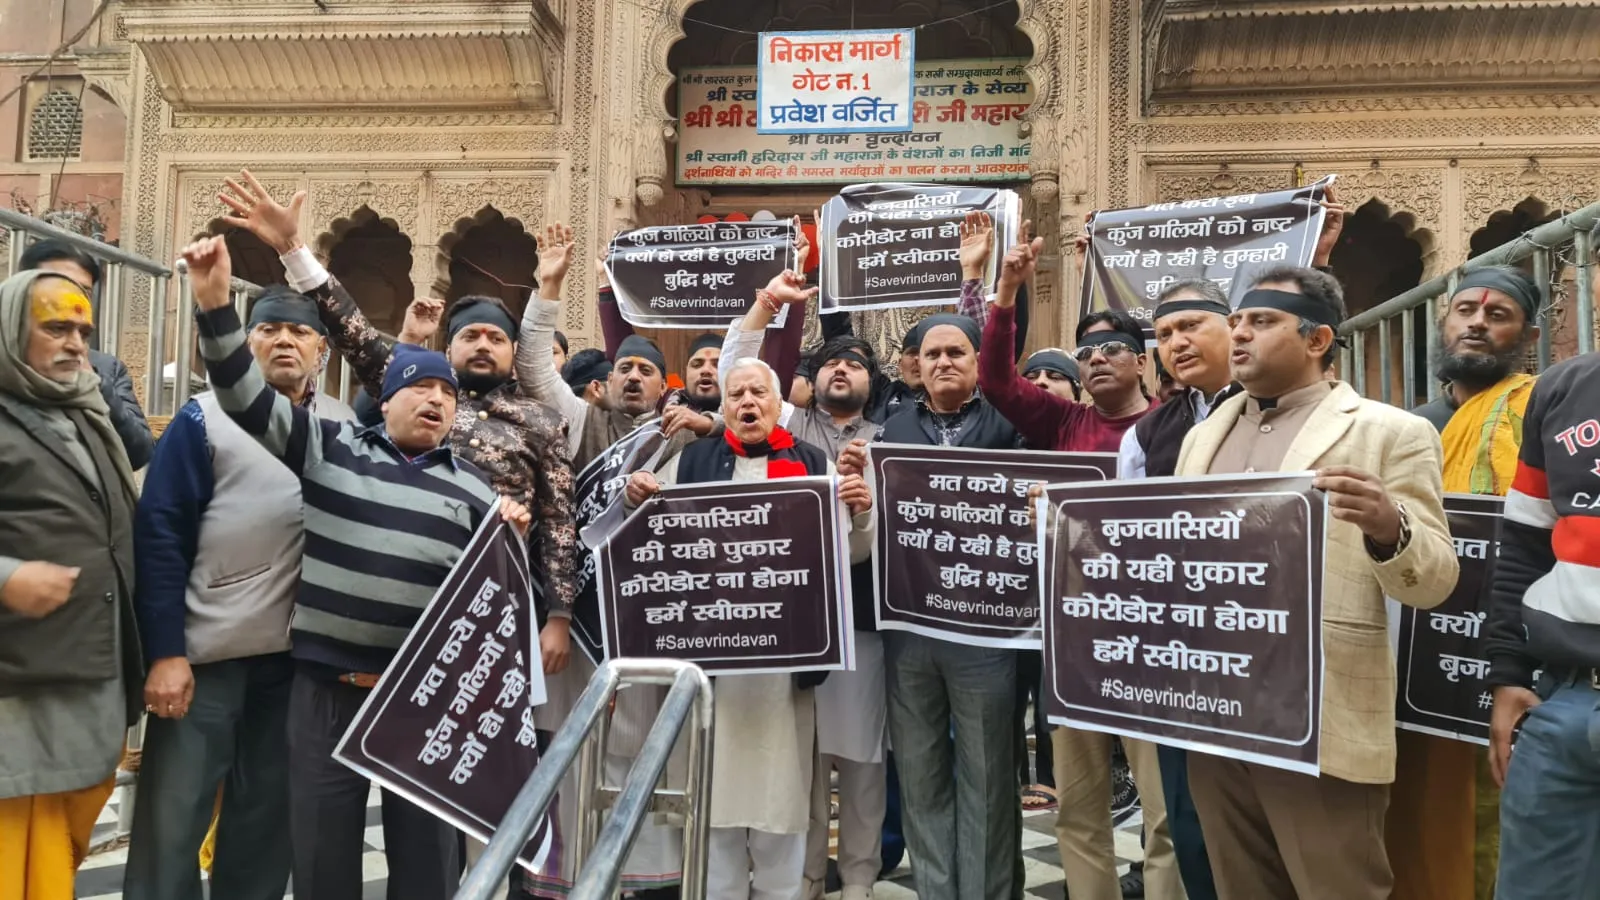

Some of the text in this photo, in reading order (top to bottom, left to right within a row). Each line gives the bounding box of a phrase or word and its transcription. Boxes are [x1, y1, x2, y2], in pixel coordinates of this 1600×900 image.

[770, 34, 901, 63] निकास मार्ग
[706, 86, 727, 102] श्री
[962, 80, 979, 95] के
[985, 79, 1029, 94] सेव्य
[792, 68, 831, 91] गेट
[684, 104, 713, 127] श्री
[716, 103, 743, 127] श्री
[936, 98, 967, 122] जी
[770, 98, 827, 124] प्रवेश
[832, 96, 898, 123] वर्जित
[816, 134, 849, 145] धाम
[866, 131, 942, 149] वृन्दावन
[686, 150, 703, 163] श्री
[707, 150, 748, 163] स्वामी
[751, 149, 804, 165] हरिदास
[810, 148, 828, 161] जी
[834, 150, 882, 163] महाराज
[887, 147, 898, 161] के
[903, 145, 945, 160] वंशजों
[949, 148, 965, 159] का
[971, 144, 1007, 159] निजी
[684, 164, 737, 180] दर्शनार्थियों
[739, 166, 751, 178] को
[755, 165, 782, 179] मन्दिर
[786, 164, 798, 177] की
[802, 166, 835, 177] समस्त
[889, 164, 902, 176] का
[907, 164, 936, 176] पालन
[940, 163, 971, 175] करना
[664, 224, 717, 242] गलियों
[719, 225, 743, 241] को
[746, 226, 778, 241] नष्ट
[836, 227, 907, 249] कोरीडोर
[911, 226, 934, 240] ना
[1107, 215, 1294, 246] कुंज गलियों को नष्ट
[724, 243, 777, 265] तुम्हारी
[857, 247, 960, 270] हमें स्वीकार
[1104, 242, 1289, 269] क्यों हो रही है तुम्हारी
[664, 269, 735, 291] बुद्धि भृष्ट
[865, 272, 957, 289] #Savevrindavan
[650, 296, 745, 310] #Savevrindavan
[929, 474, 963, 492] मत
[967, 473, 1008, 494] करो
[648, 502, 773, 536] बृजवासियों
[897, 496, 936, 524] कुंज
[940, 501, 1006, 526] गलियों
[1101, 508, 1246, 546] बृजवासियों
[632, 538, 793, 563] की यही पुकार
[897, 528, 933, 550] क्यों
[934, 531, 955, 552] हो
[960, 534, 992, 556] रही
[996, 536, 1013, 558] है
[620, 570, 711, 597] कोरीडोर
[715, 571, 746, 589] ना
[751, 566, 810, 590] होगा
[940, 563, 1030, 594] बुद्धि भृष्ट
[1081, 553, 1269, 592] की यही पुकार
[645, 599, 784, 625] हमें स्वीकार
[1062, 592, 1289, 635] कोरीडोर ना होगा
[1430, 611, 1487, 638] क्यों
[410, 576, 501, 707] मत करो इन
[655, 632, 778, 651] #Savevrindavan
[1093, 635, 1252, 678] हमें स्वीकार
[417, 713, 459, 765] कुंज
[448, 632, 506, 715] गलियों
[1101, 678, 1242, 717] #Savevrindavan
[449, 667, 526, 784] क्यों हो रही
